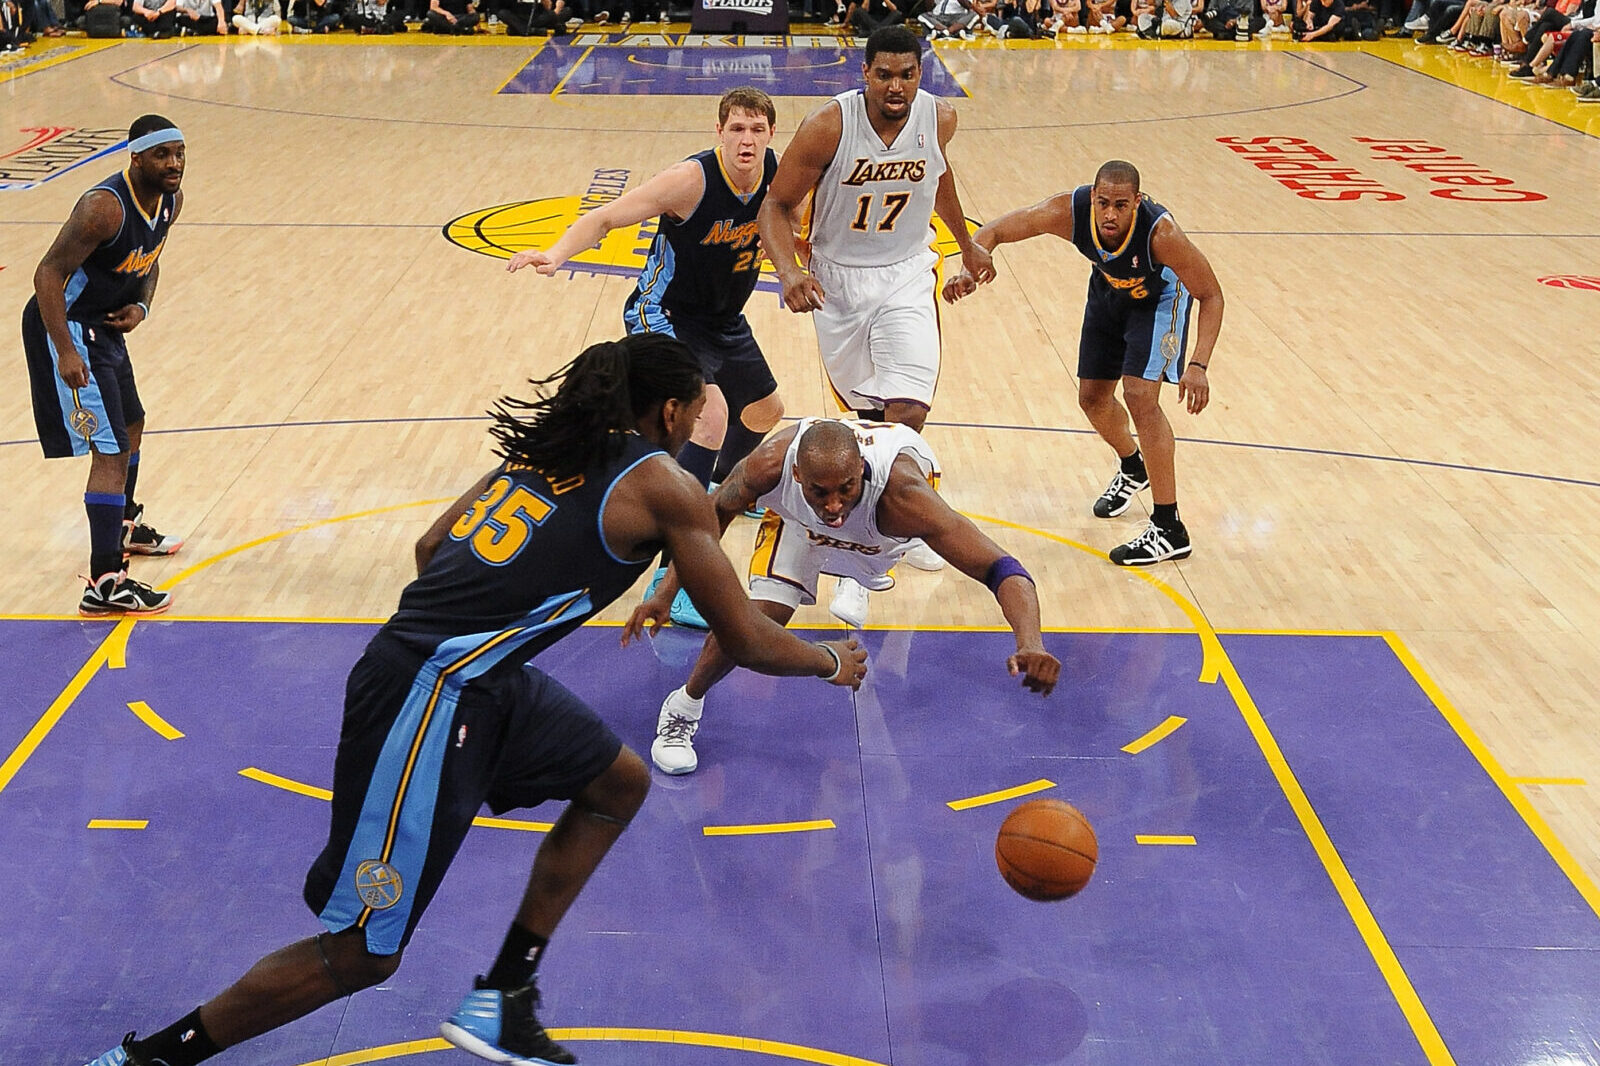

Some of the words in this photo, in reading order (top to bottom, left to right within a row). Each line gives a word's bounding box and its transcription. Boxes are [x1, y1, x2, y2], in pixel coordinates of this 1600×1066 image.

[576, 168, 631, 216] NGELES
[841, 157, 927, 186] LAKERS
[1215, 136, 1407, 202] STAPLES
[1350, 136, 1549, 202] Center
[850, 192, 912, 233] 17
[1131, 285, 1148, 299] 6
[449, 475, 558, 567] 35
